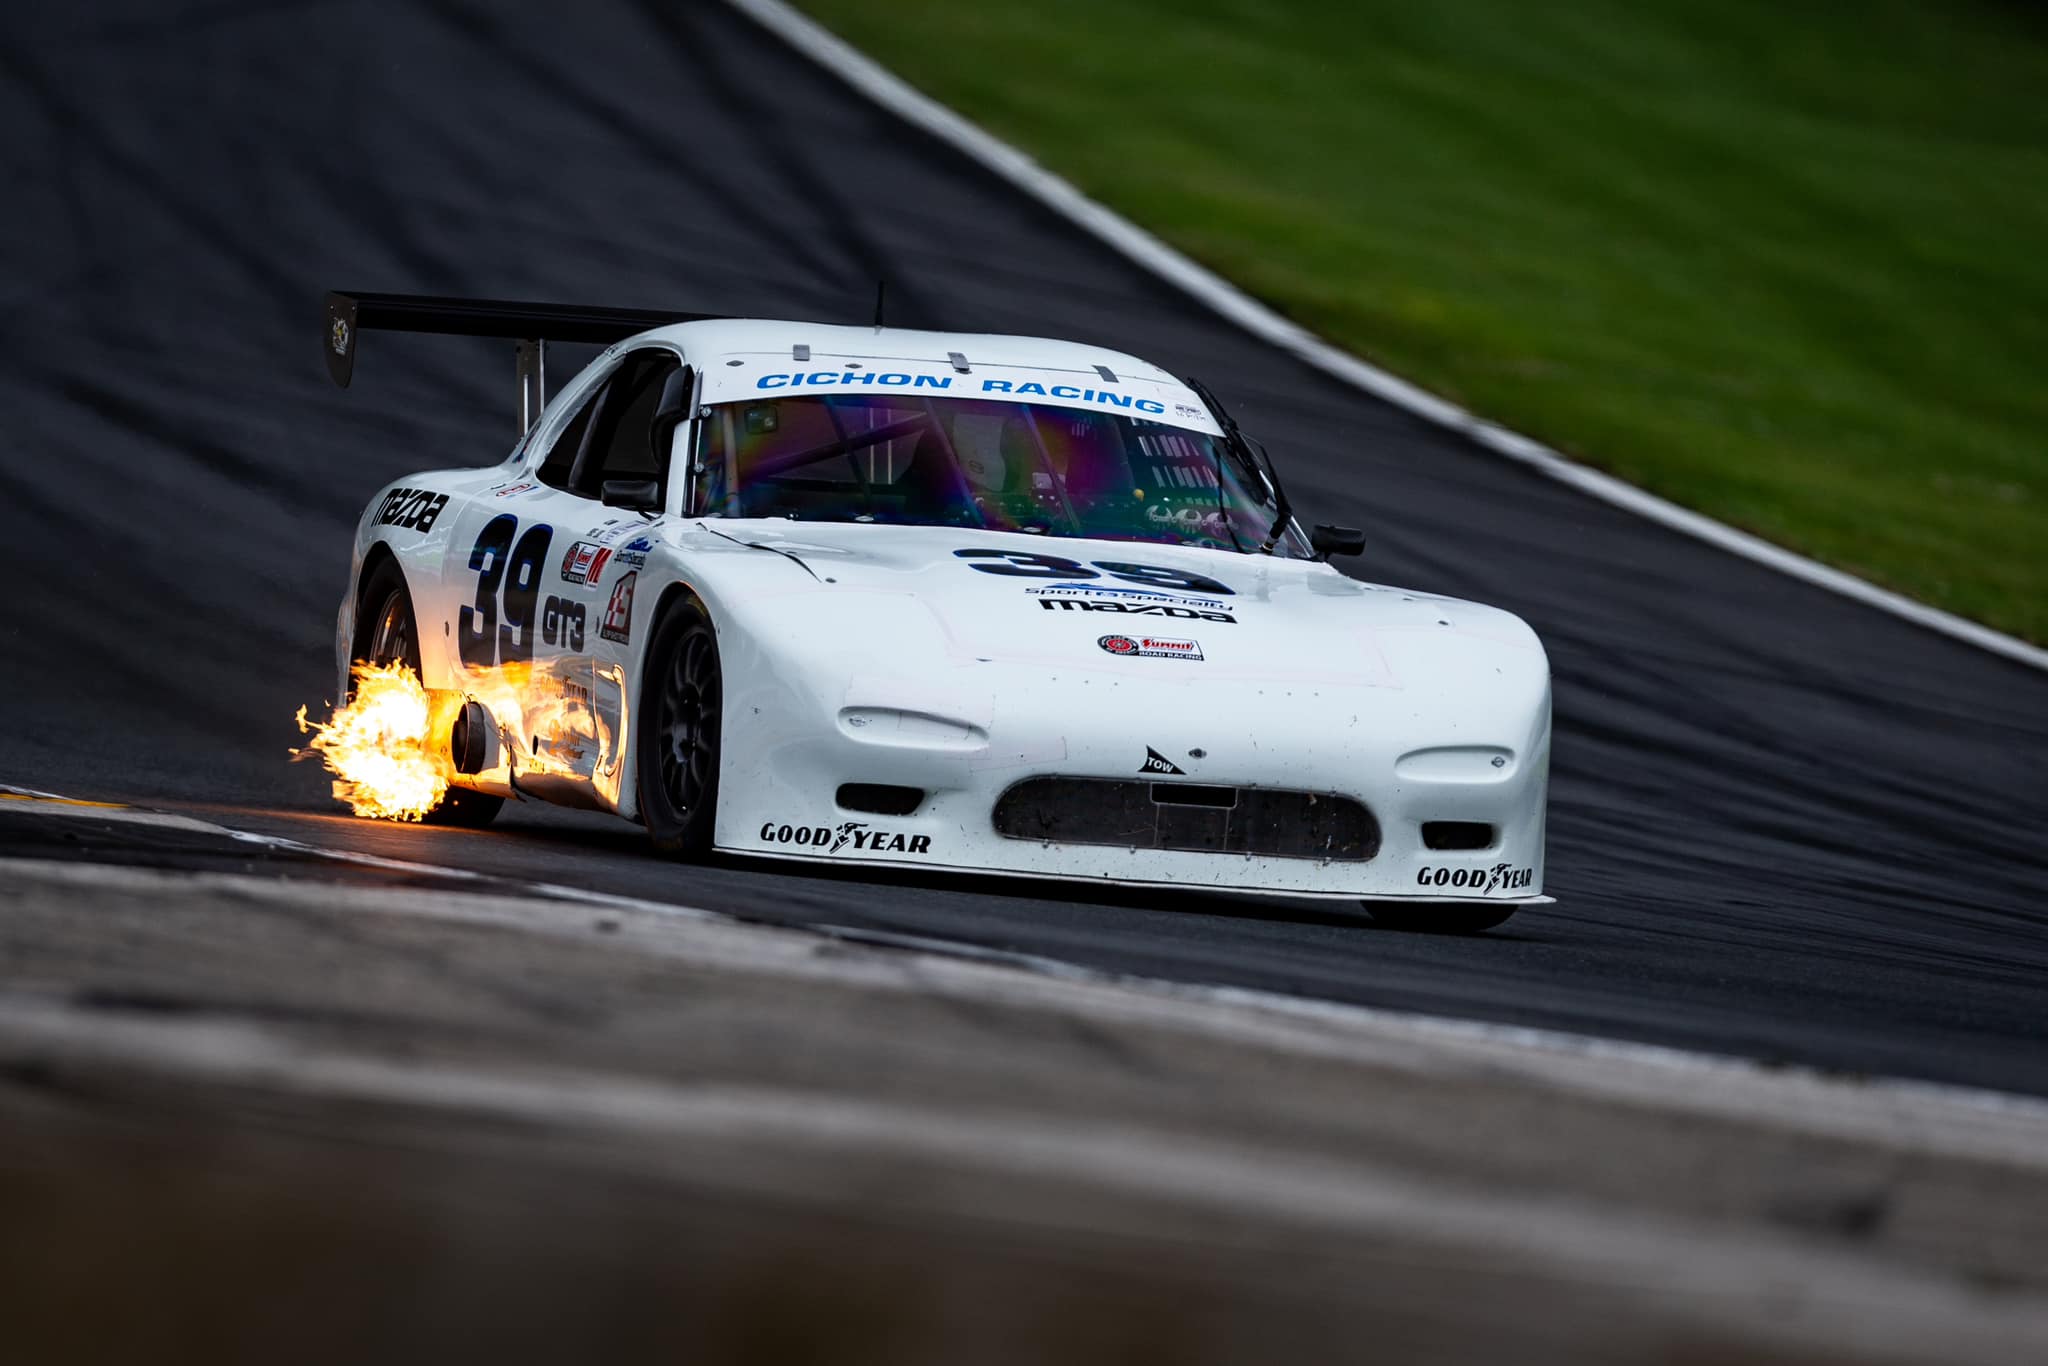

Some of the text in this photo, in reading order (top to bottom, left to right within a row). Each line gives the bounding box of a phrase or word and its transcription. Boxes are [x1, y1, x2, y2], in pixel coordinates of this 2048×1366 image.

[756, 372, 952, 389] CICHON
[982, 379, 1166, 414] RACING
[953, 549, 1237, 595] 39
[459, 513, 553, 686] 39
[542, 595, 586, 652] GT3
[1147, 757, 1174, 773] TOW
